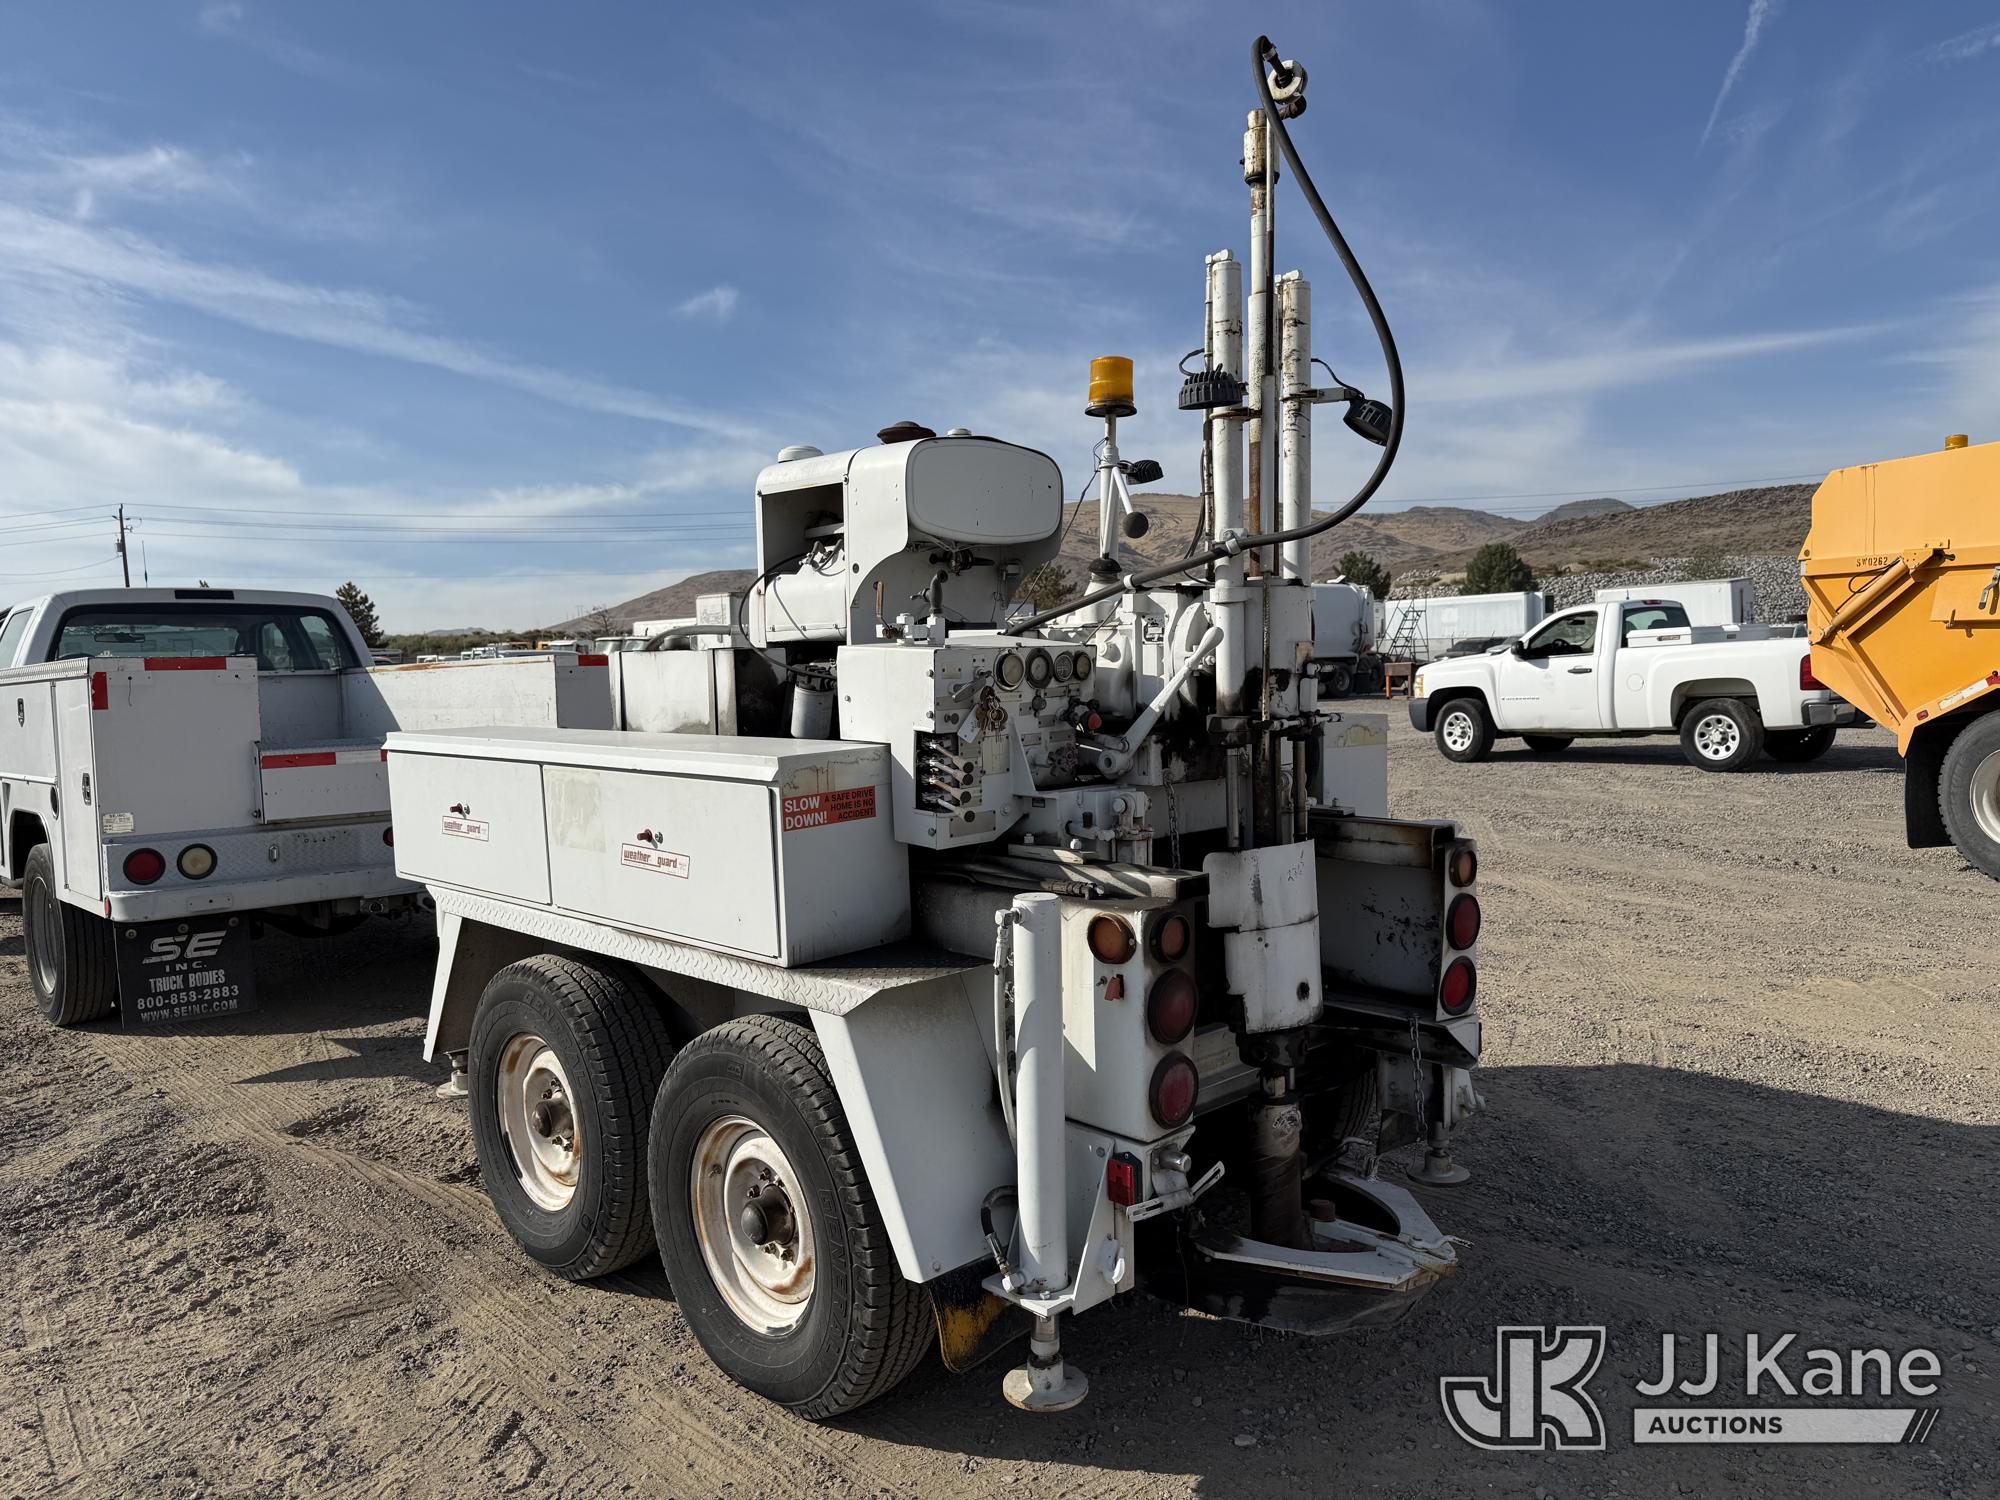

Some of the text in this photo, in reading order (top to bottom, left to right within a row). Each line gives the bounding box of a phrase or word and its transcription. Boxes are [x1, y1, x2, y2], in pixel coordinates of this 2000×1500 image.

[1856, 557, 1888, 568] SW0262
[785, 796, 820, 813] SLOW
[824, 789, 873, 803] A SAFE DRIVE
[831, 799, 874, 812] HOME IS NO
[838, 807, 874, 819] ACCIDENT
[785, 811, 828, 830] DOWN!
[624, 850, 678, 868] weather guard
[142, 930, 227, 964] SE
[165, 960, 207, 973] INC.
[149, 969, 226, 993] TRUCK BODIES
[137, 985, 240, 1010] 800-858-2883
[140, 998, 238, 1023] WWW.SEINC.COM
